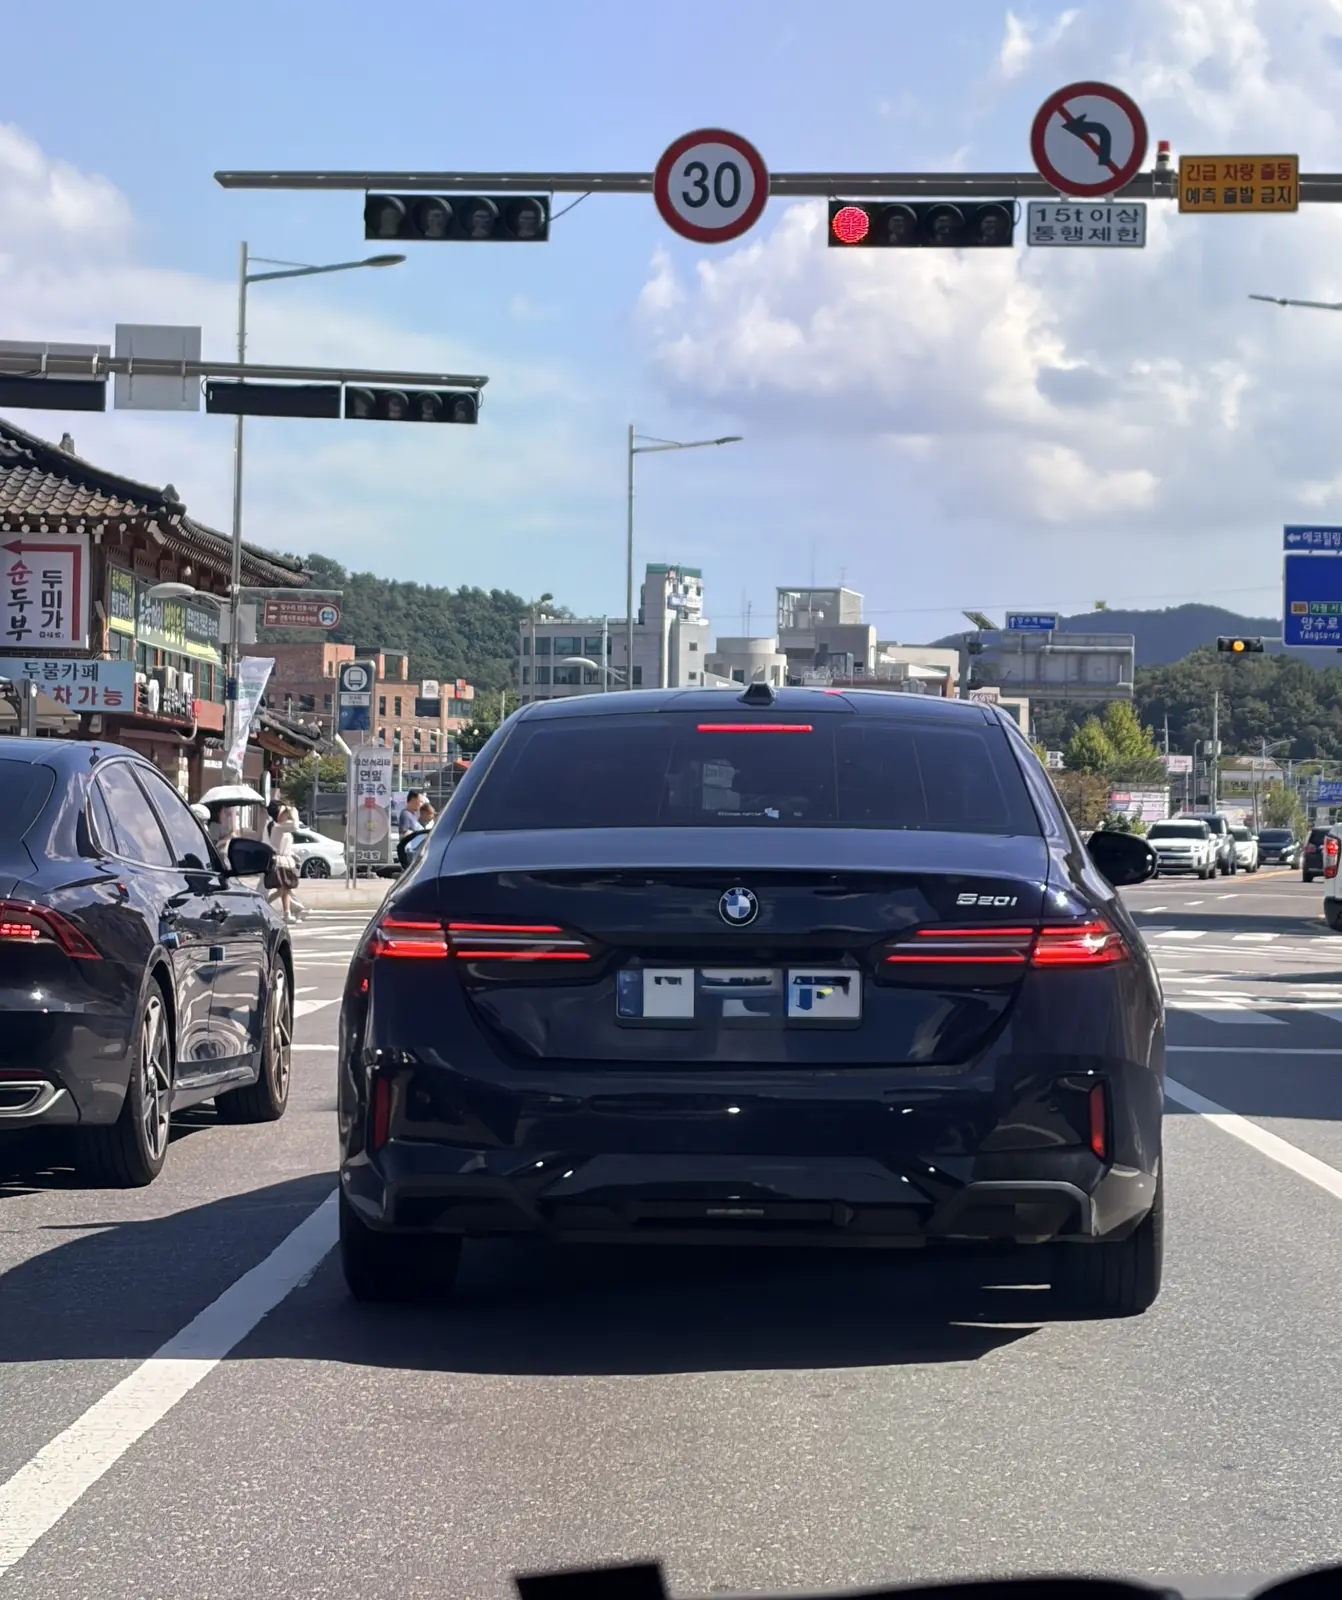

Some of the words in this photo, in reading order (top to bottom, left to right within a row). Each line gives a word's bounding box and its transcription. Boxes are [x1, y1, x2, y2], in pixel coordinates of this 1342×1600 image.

[1186, 163, 1217, 181] 긴급
[1223, 163, 1254, 181] 차량
[1260, 163, 1291, 181] 출동
[682, 161, 741, 208] 30
[1185, 186, 1217, 204] 예측
[1223, 186, 1254, 204] 출발
[1261, 186, 1291, 204] 금지
[1032, 225, 1140, 242] 통행제한
[1302, 531, 1342, 546] 에코힐링
[6, 560, 33, 641] 순두부
[41, 570, 64, 629] 두미가
[1301, 616, 1339, 630] 양수로
[1299, 631, 1341, 641] Yangsu-ro
[22, 662, 99, 682] 두물카페
[40, 684, 123, 706] 차가능
